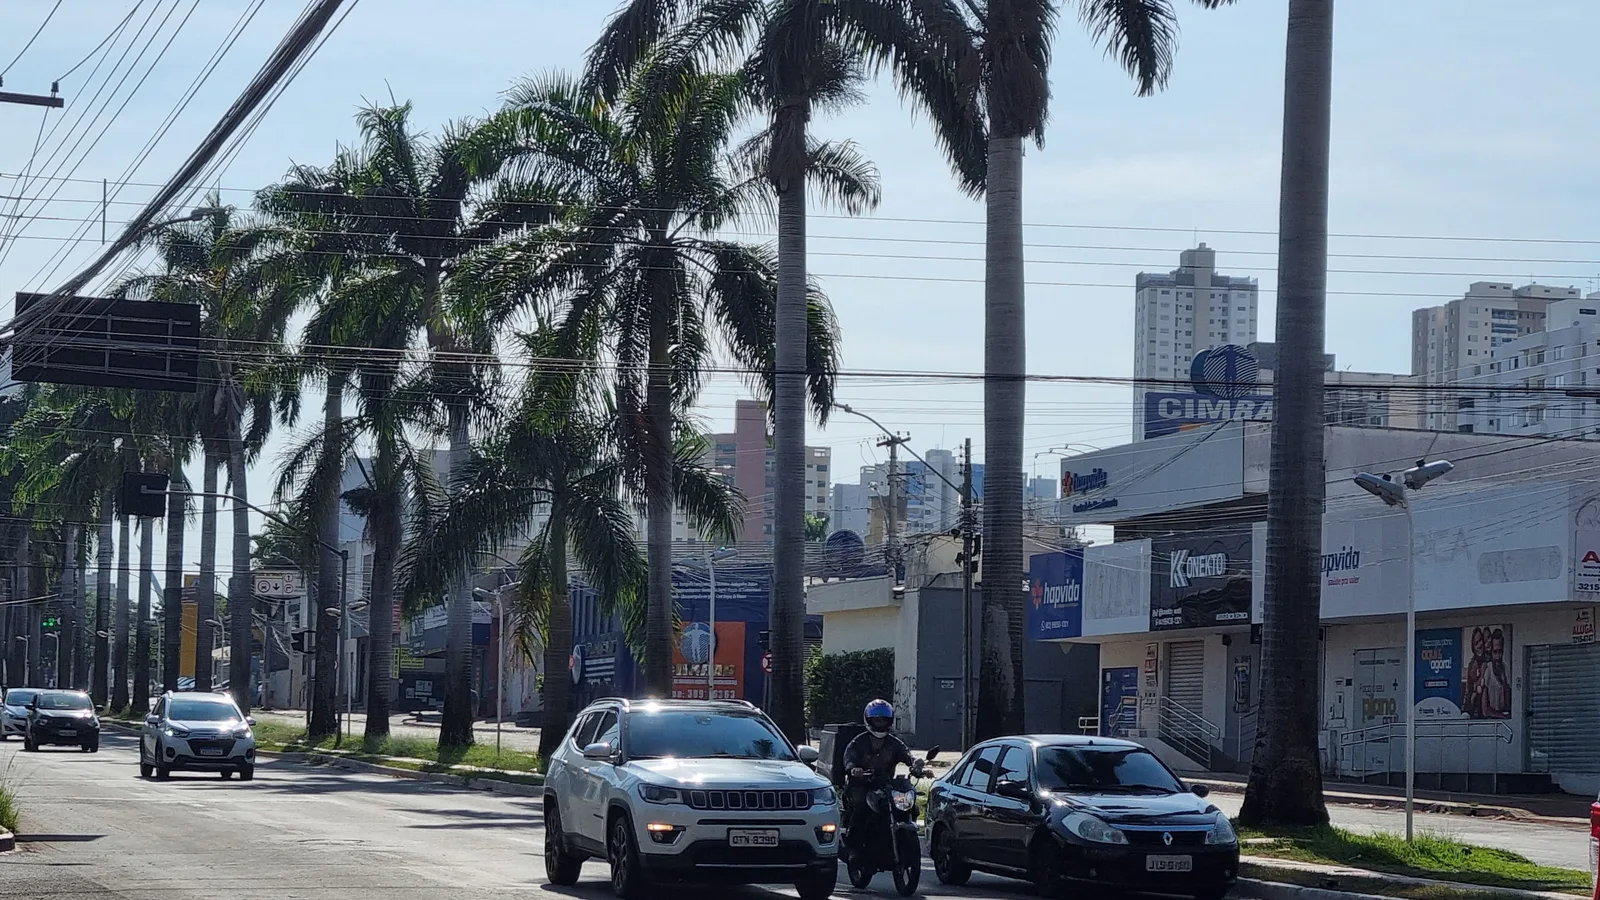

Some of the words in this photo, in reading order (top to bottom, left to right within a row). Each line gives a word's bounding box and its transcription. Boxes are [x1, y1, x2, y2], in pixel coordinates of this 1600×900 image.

[1169, 549, 1228, 588] KONEKTO
[1043, 579, 1080, 609] hapvida
[1572, 624, 1594, 635] ALUGA
[1430, 657, 1452, 673] agora!
[1362, 698, 1396, 723] plano
